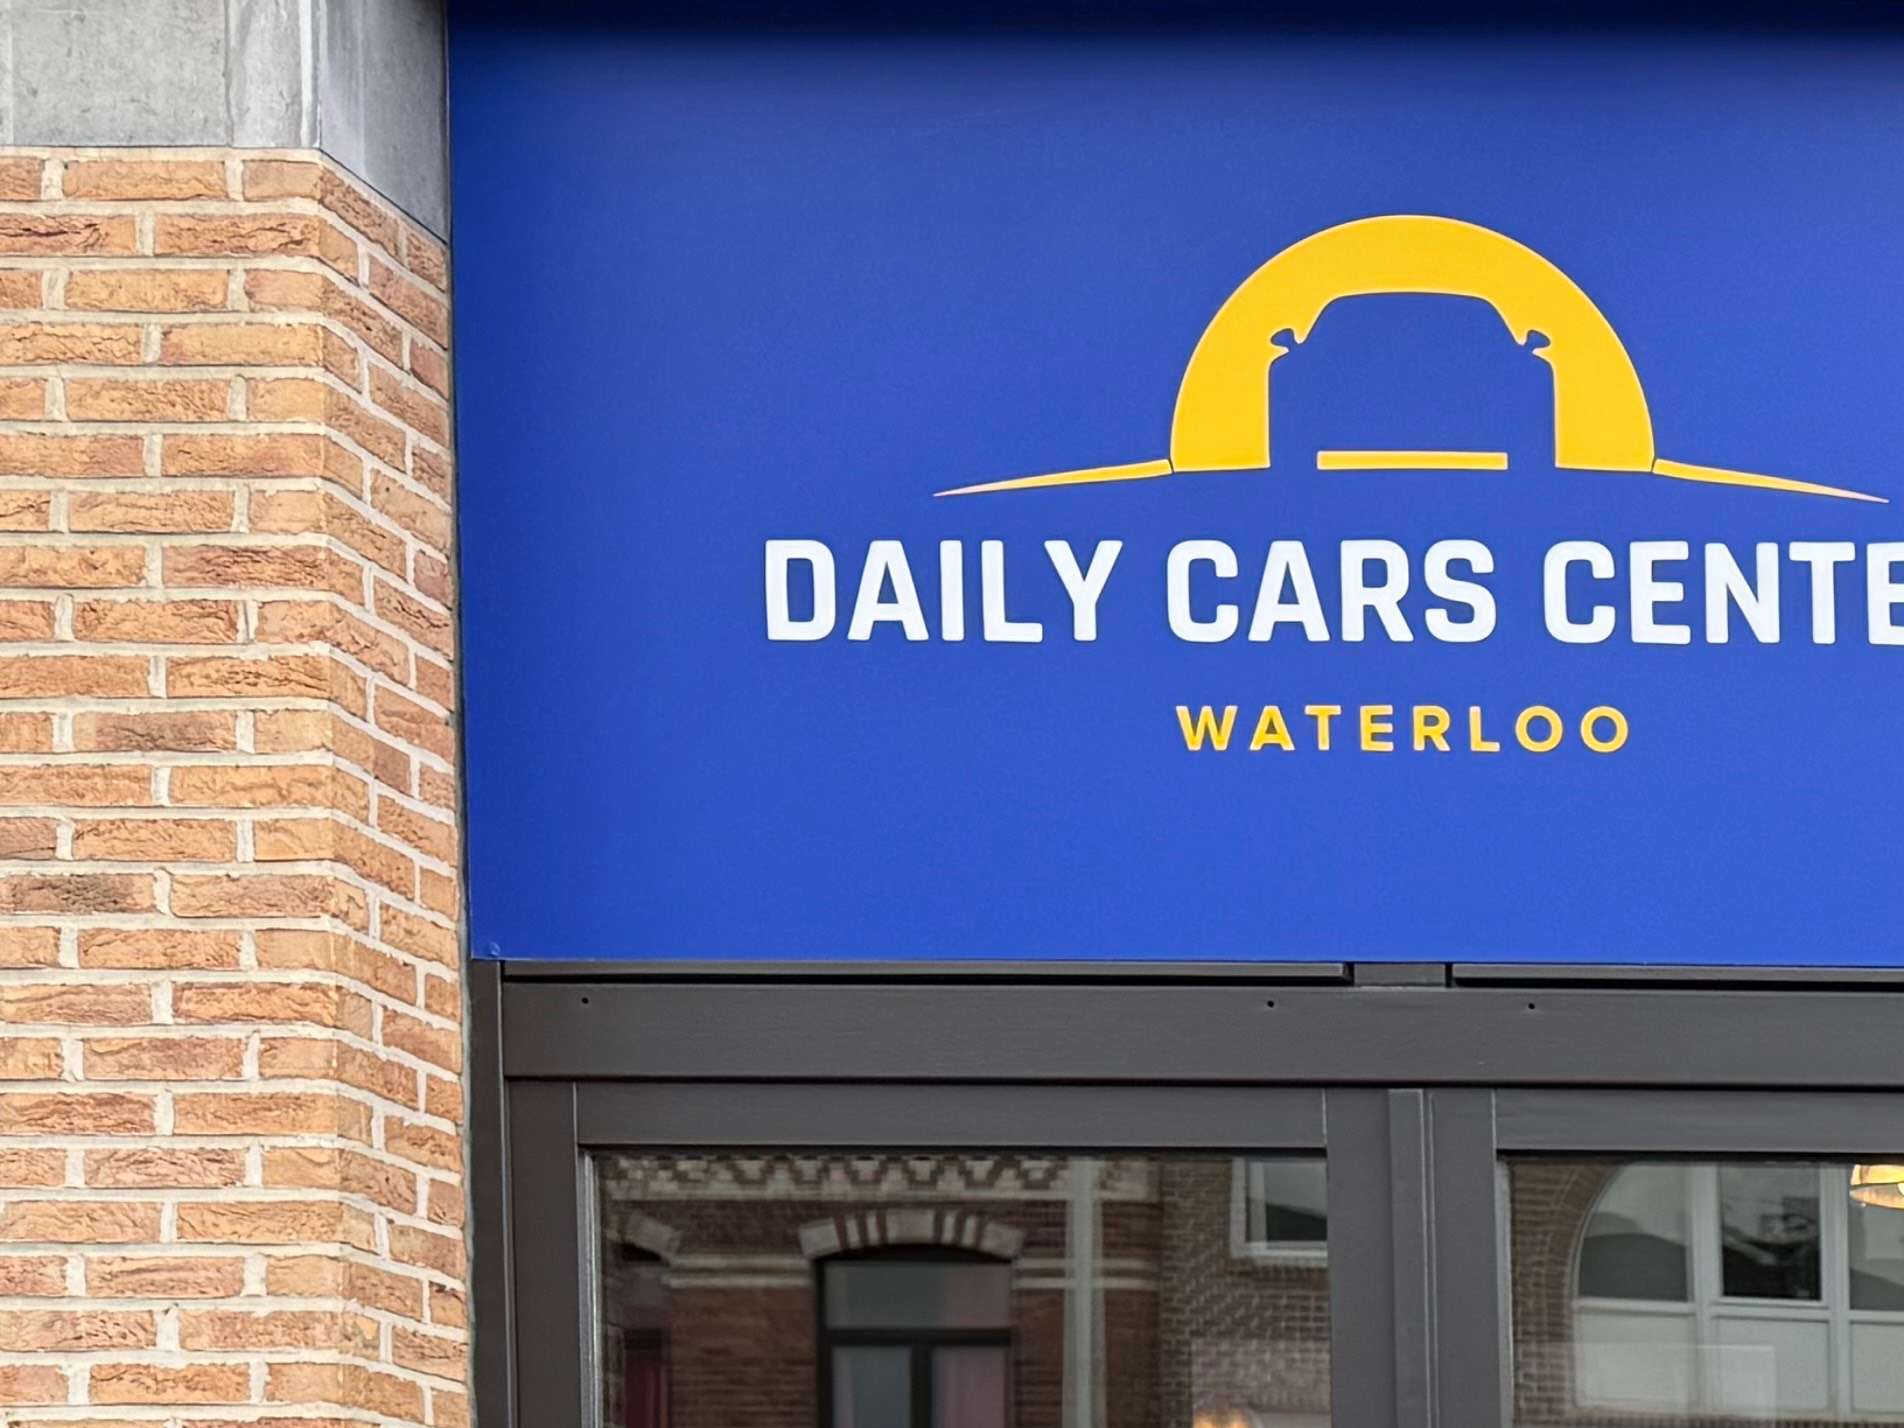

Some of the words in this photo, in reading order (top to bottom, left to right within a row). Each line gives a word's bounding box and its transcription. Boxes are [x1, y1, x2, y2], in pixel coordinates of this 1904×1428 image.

[763, 538, 1123, 642] DAILY
[1166, 538, 1498, 644] CARS
[1175, 703, 1631, 755] WATERLOO
